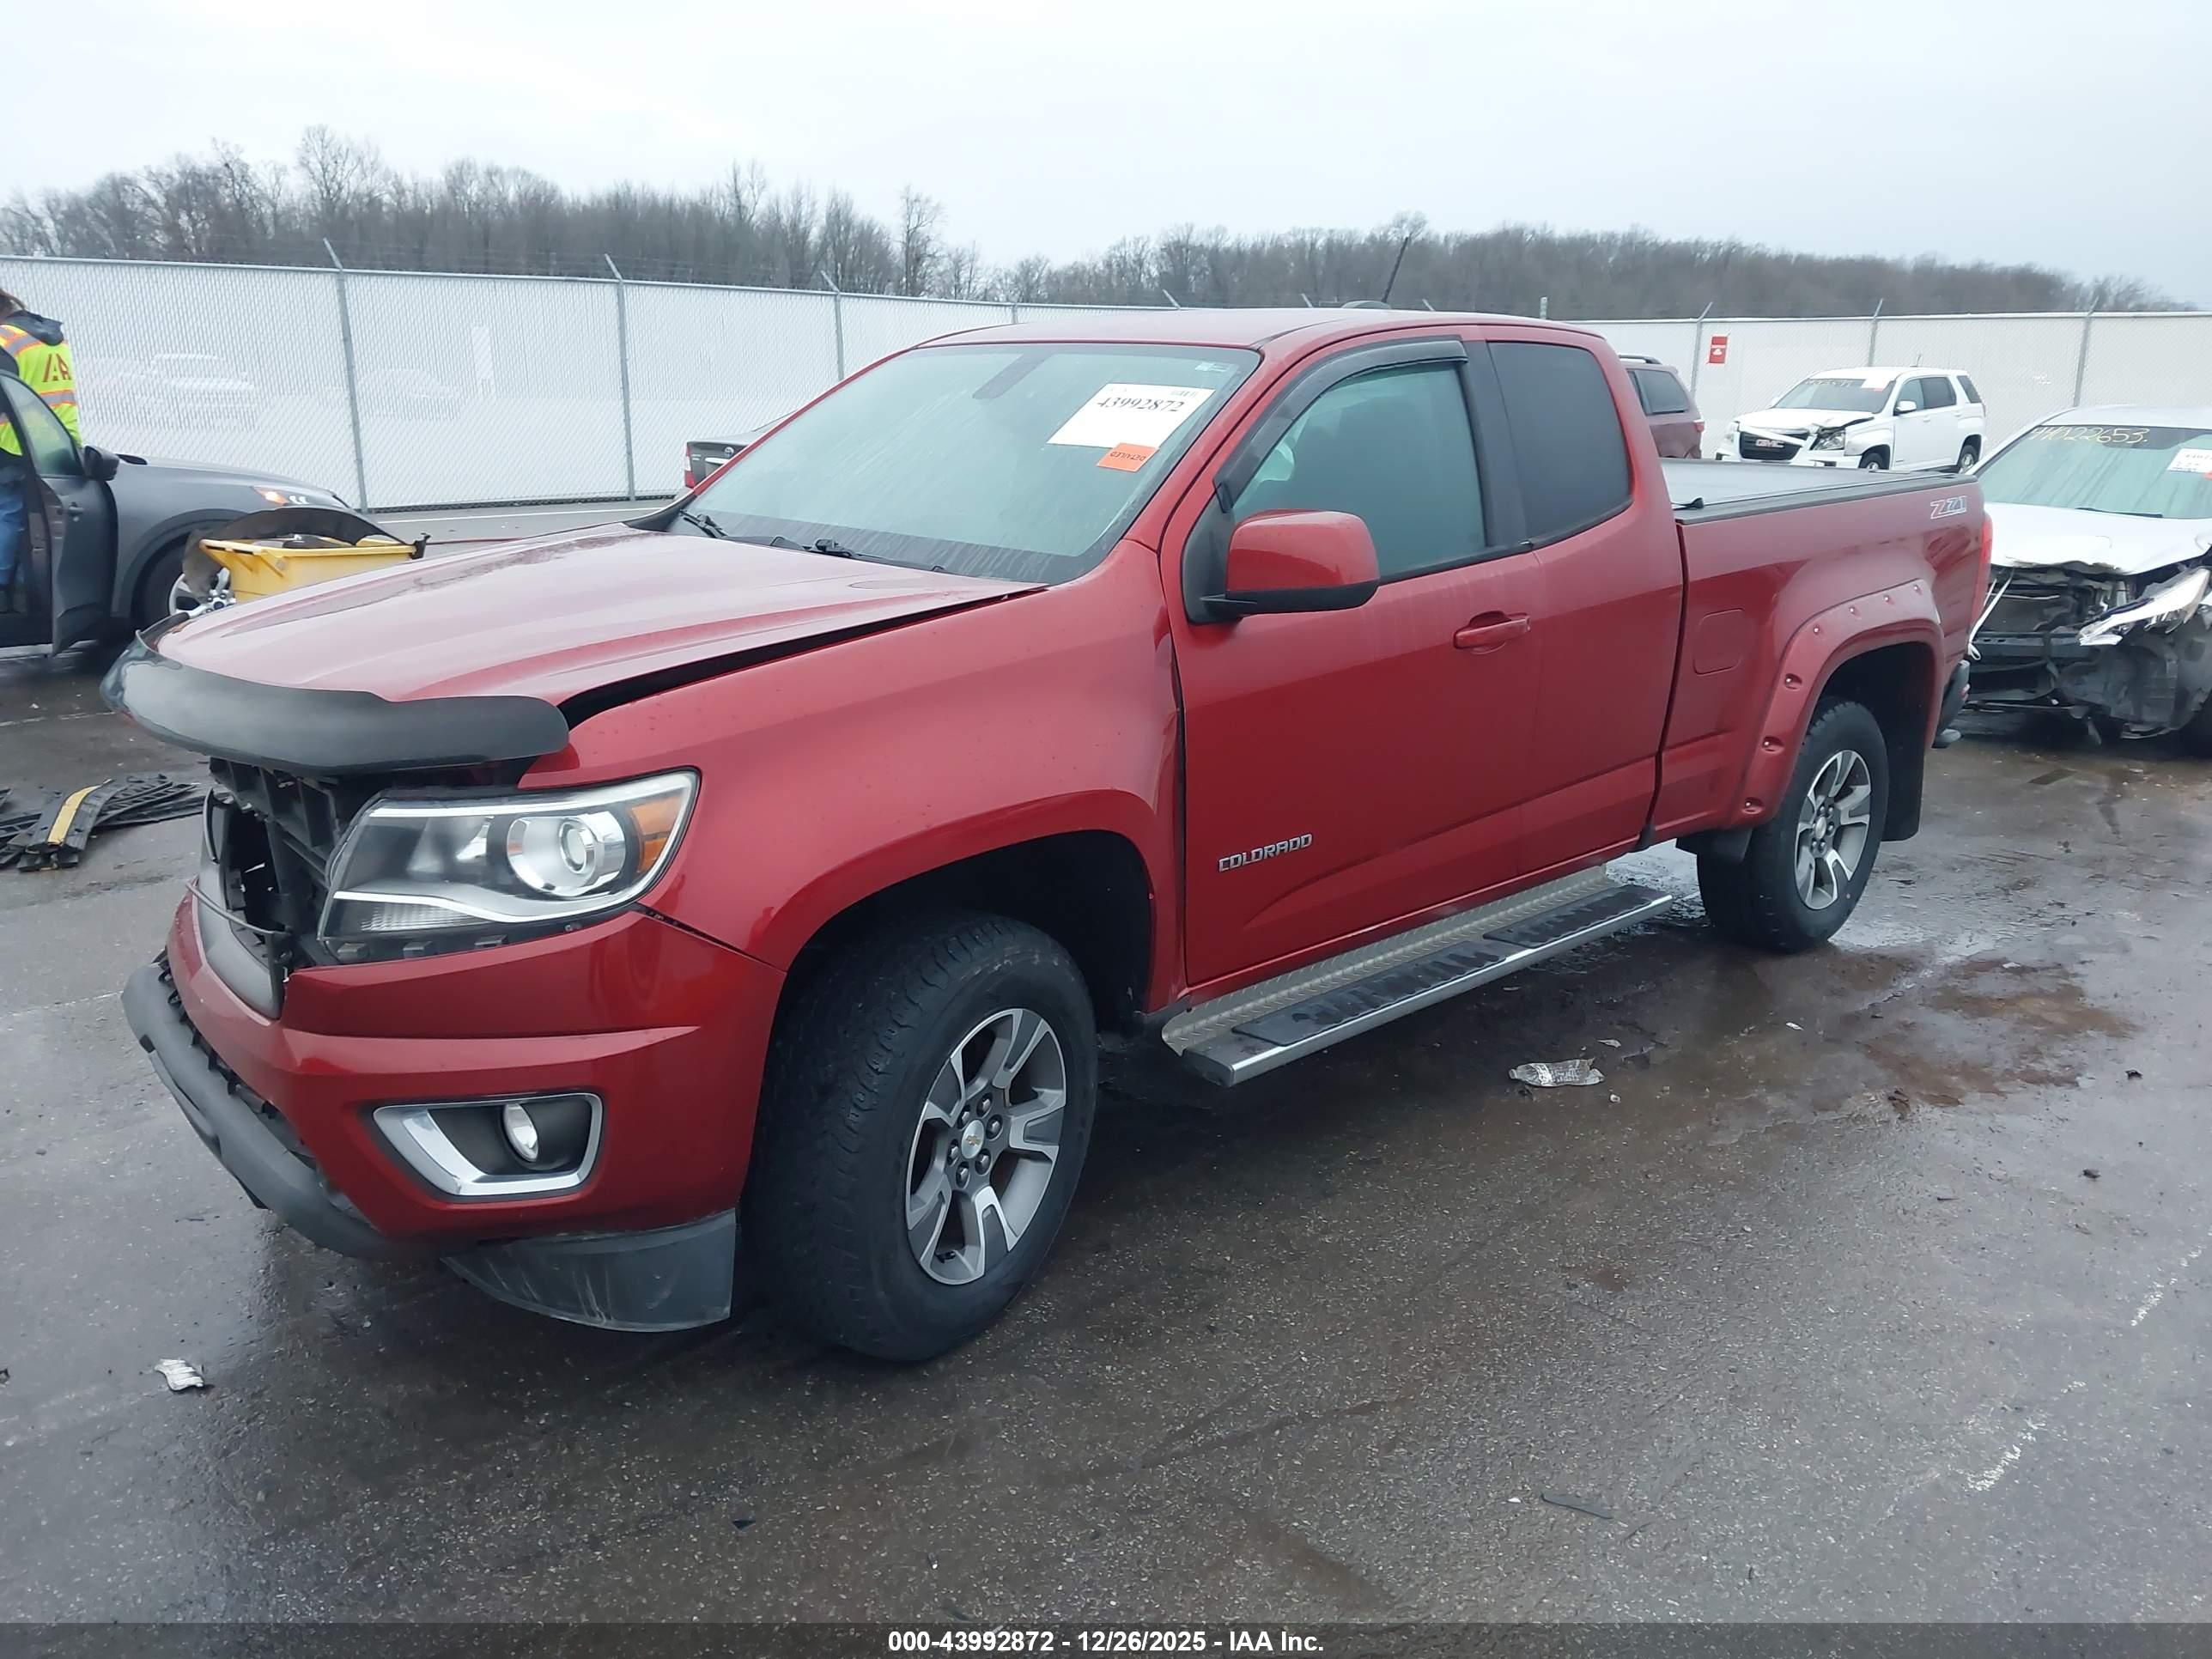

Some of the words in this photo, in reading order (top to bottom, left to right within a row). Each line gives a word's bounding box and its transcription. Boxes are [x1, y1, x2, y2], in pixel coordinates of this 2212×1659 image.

[1097, 397, 1185, 412] 43992872
[1755, 439, 1785, 448] GMC
[1929, 495, 1967, 520] Z71
[1218, 834, 1313, 872] COLORADO
